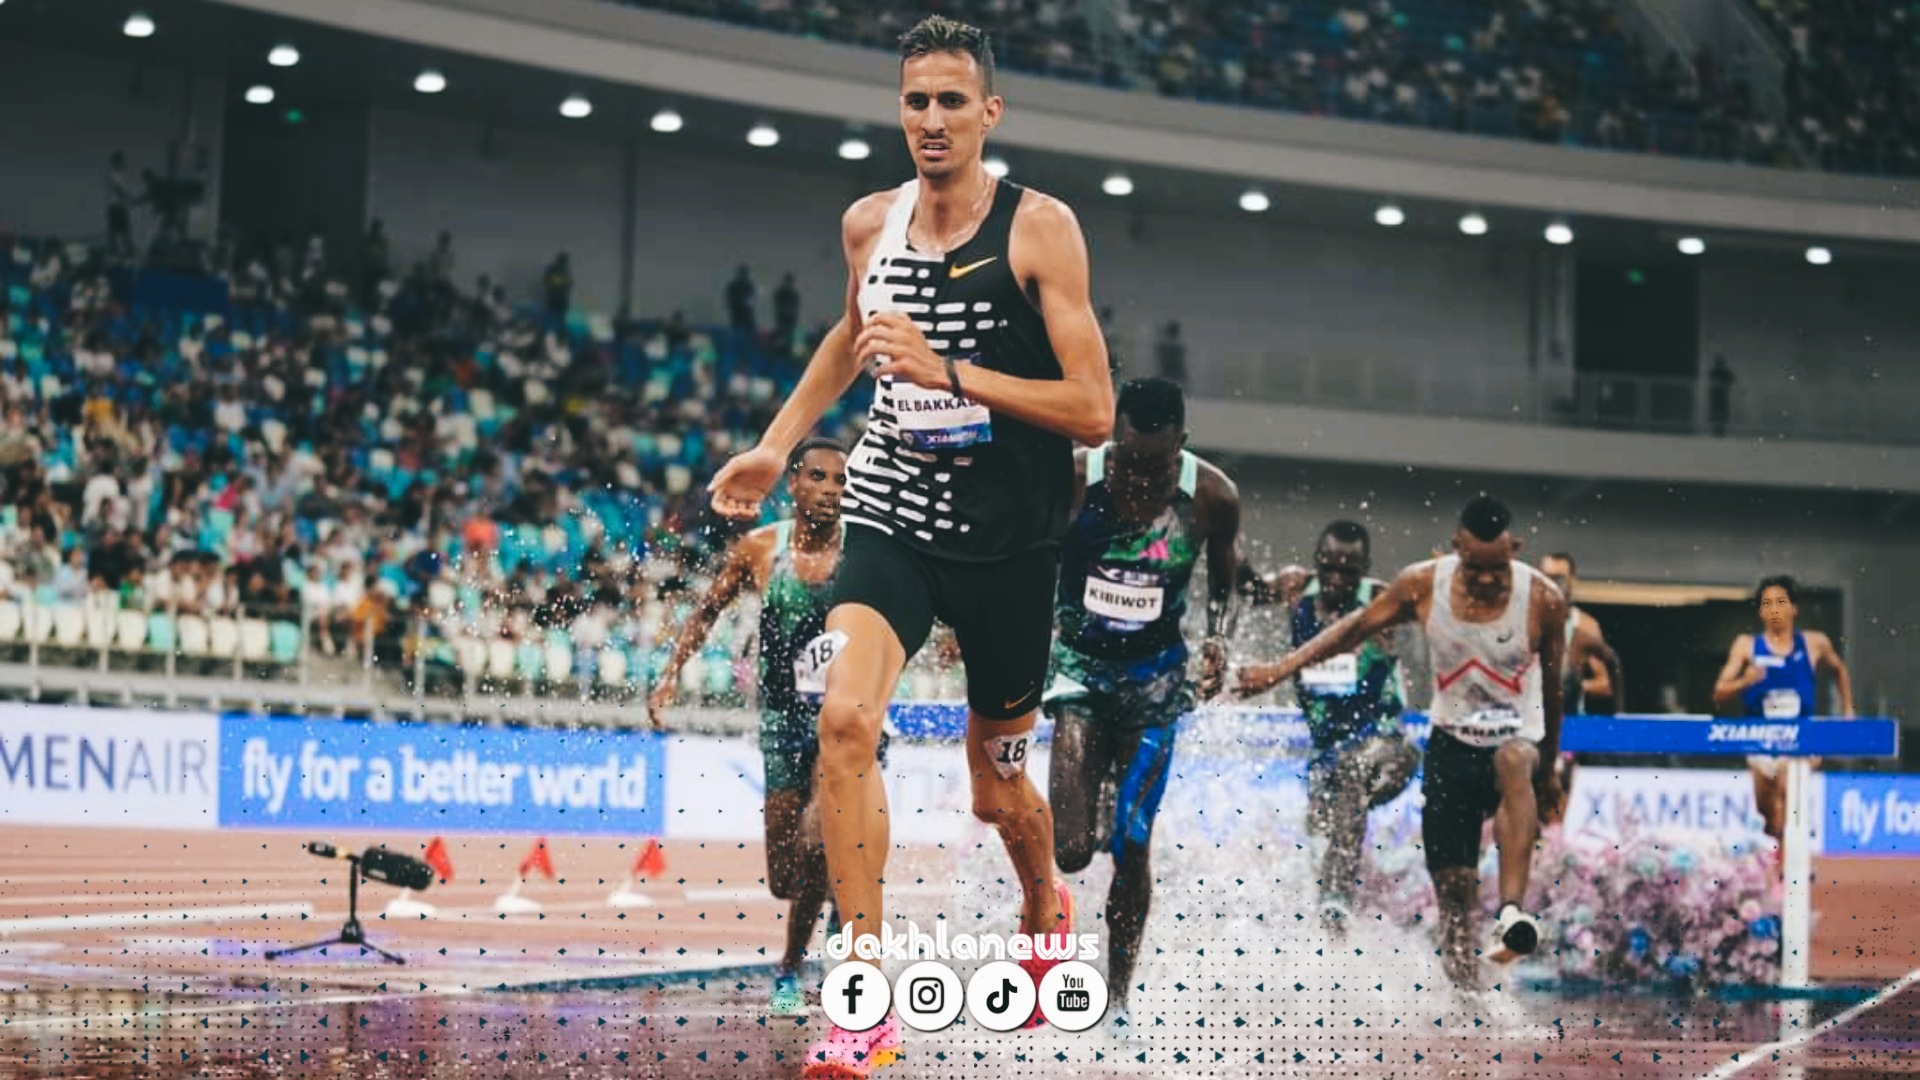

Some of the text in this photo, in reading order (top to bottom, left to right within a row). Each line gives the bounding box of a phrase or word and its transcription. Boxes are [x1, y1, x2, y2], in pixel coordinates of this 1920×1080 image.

[1088, 587, 1158, 609] KIBIWOT
[811, 639, 833, 671] 18
[1708, 724, 1799, 742] XIAMEN
[997, 738, 1027, 764] 18
[243, 737, 645, 813] fly for a better world
[1585, 788, 1750, 829] XIAMEN
[1842, 789, 1879, 844] fly
